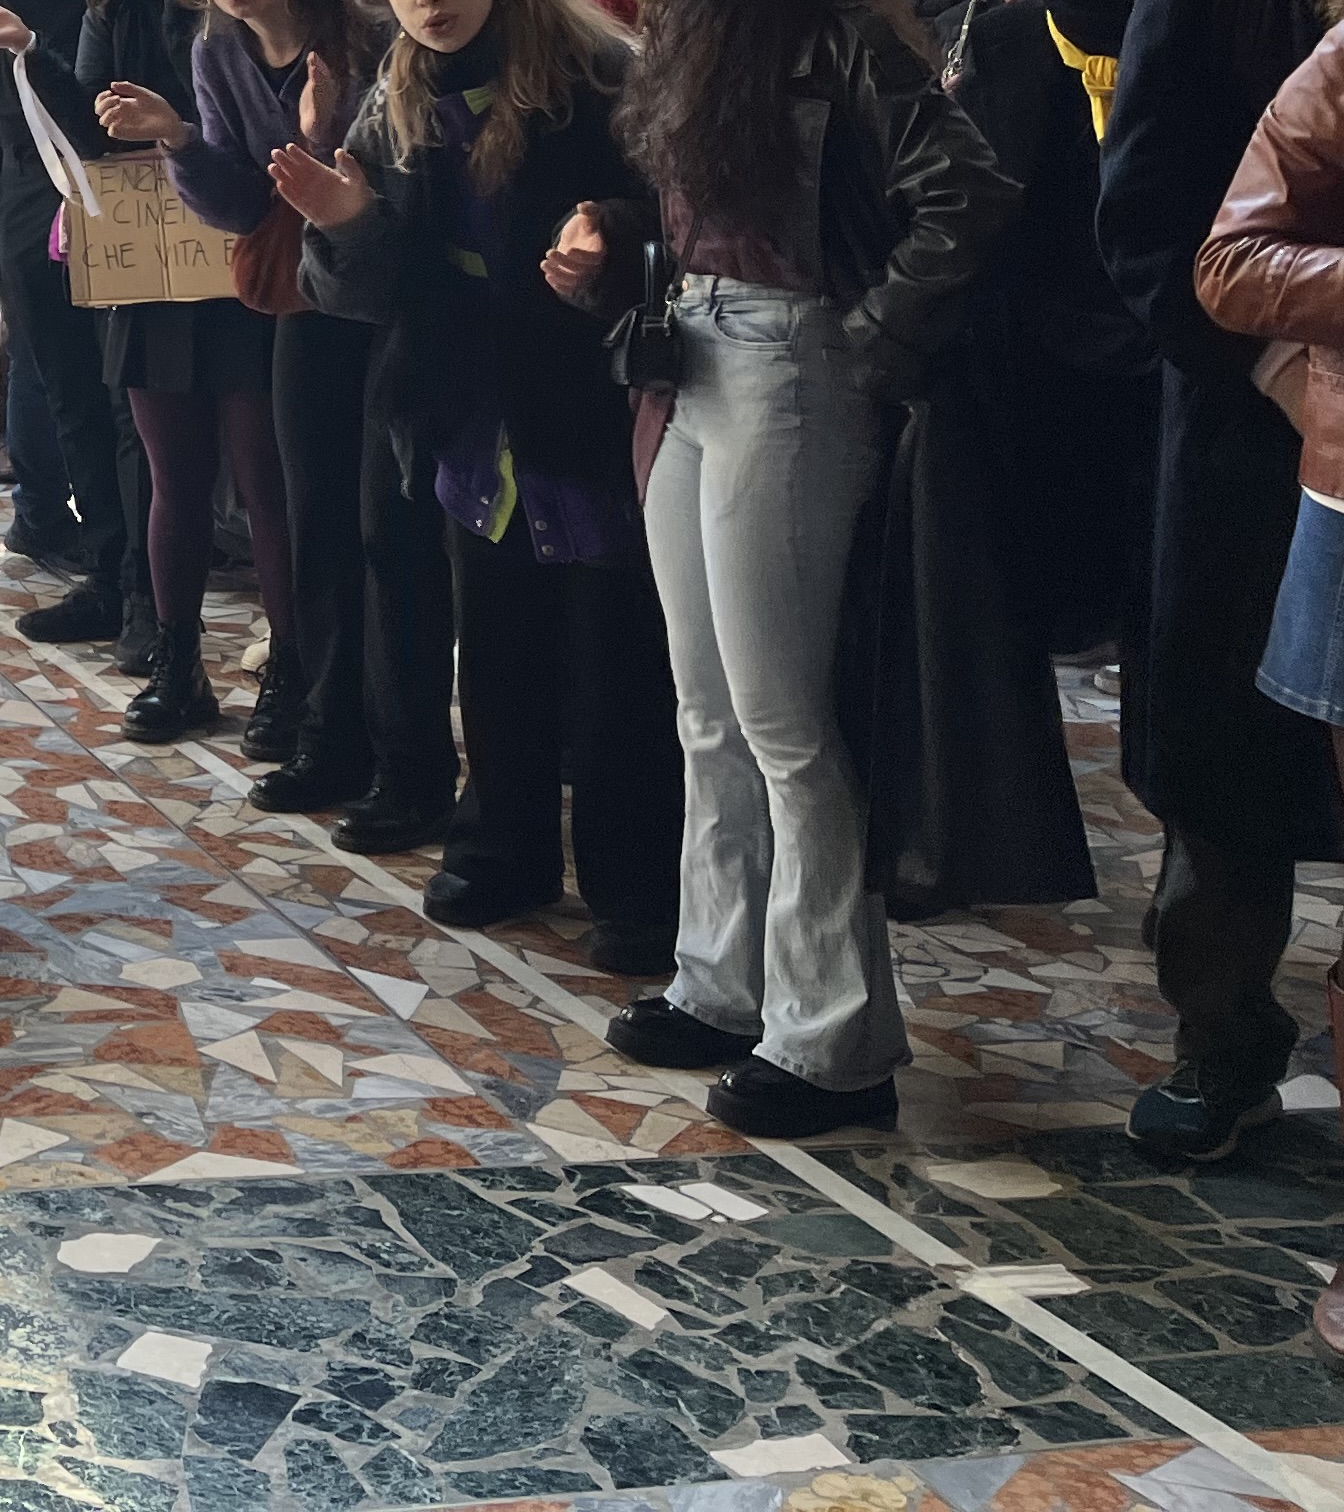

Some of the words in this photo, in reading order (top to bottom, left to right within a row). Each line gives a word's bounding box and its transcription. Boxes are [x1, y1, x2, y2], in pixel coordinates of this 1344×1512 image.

[88, 164, 169, 196] ENZA
[82, 242, 137, 271] CHE
[155, 239, 210, 268] VITA
